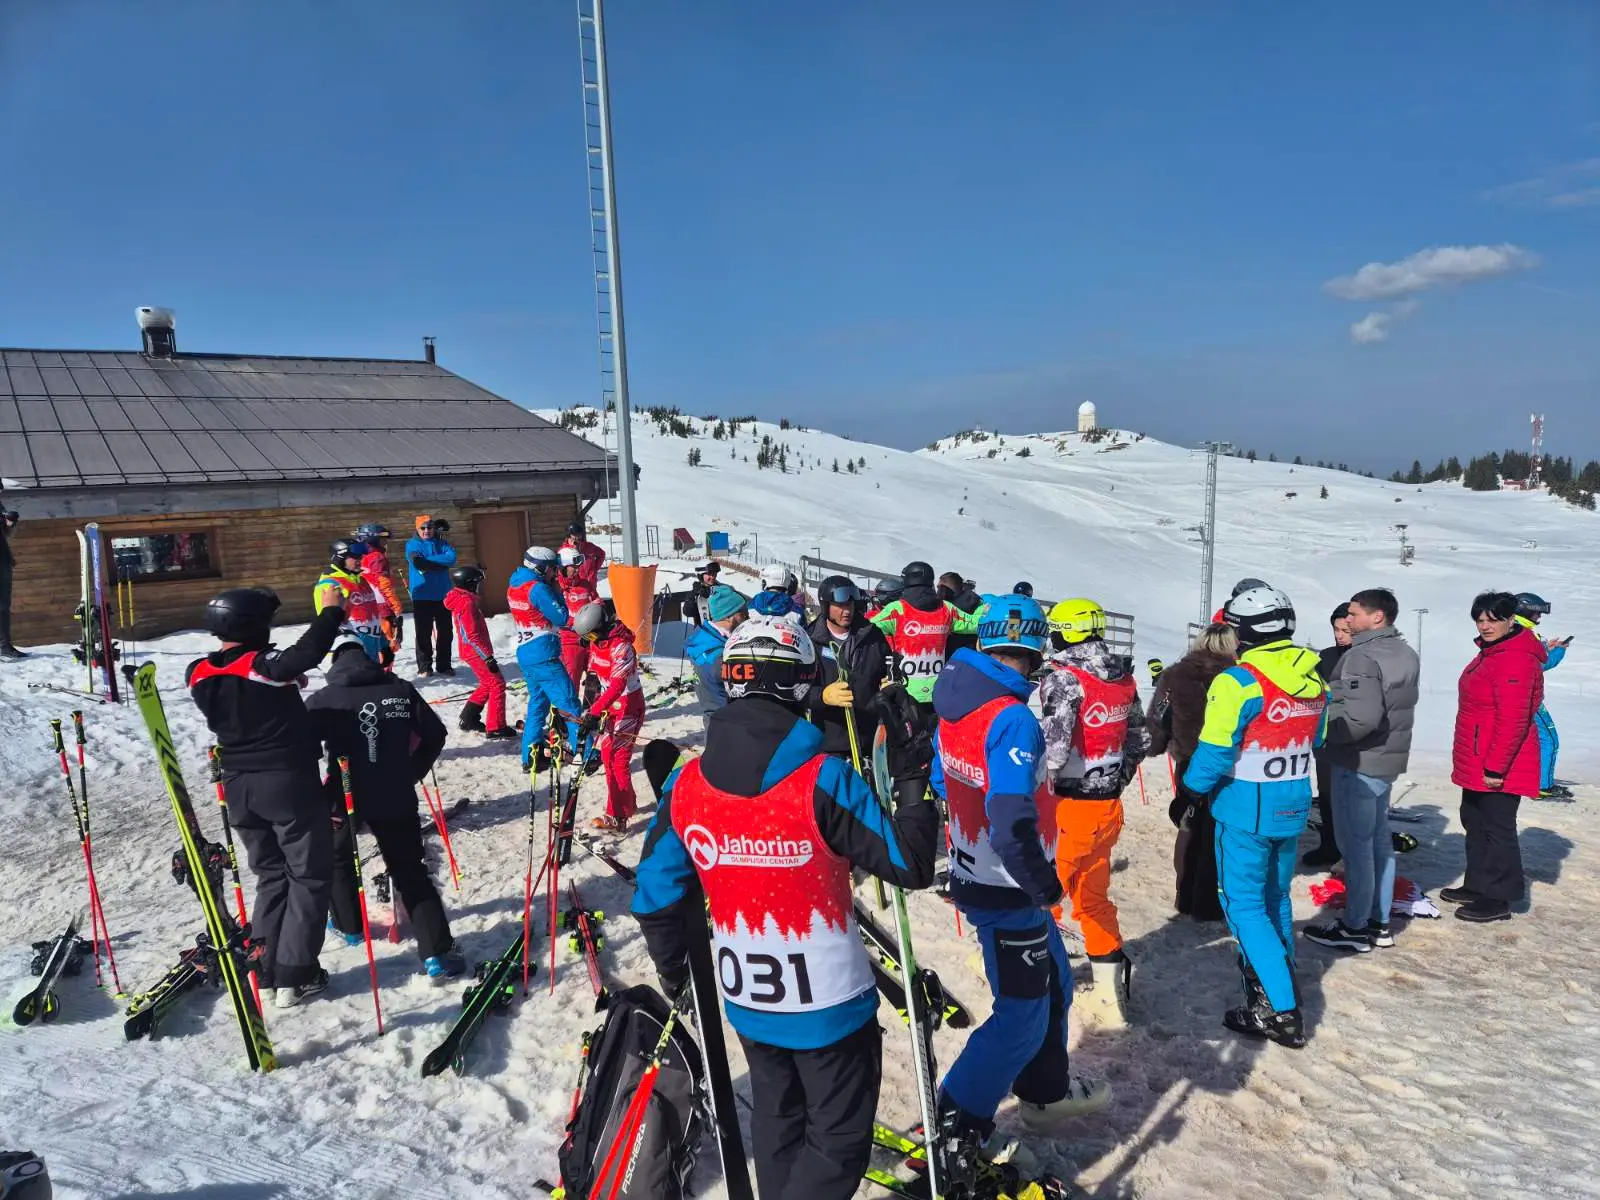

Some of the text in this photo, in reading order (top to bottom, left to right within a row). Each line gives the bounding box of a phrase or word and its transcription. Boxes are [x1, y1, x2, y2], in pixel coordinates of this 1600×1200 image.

[902, 660, 944, 676] 040
[381, 698, 411, 706] OFFICIA
[1263, 753, 1311, 778] 017
[719, 834, 813, 856] Jahorina
[718, 946, 813, 1005] 031
[621, 1130, 644, 1194] FISCHER
